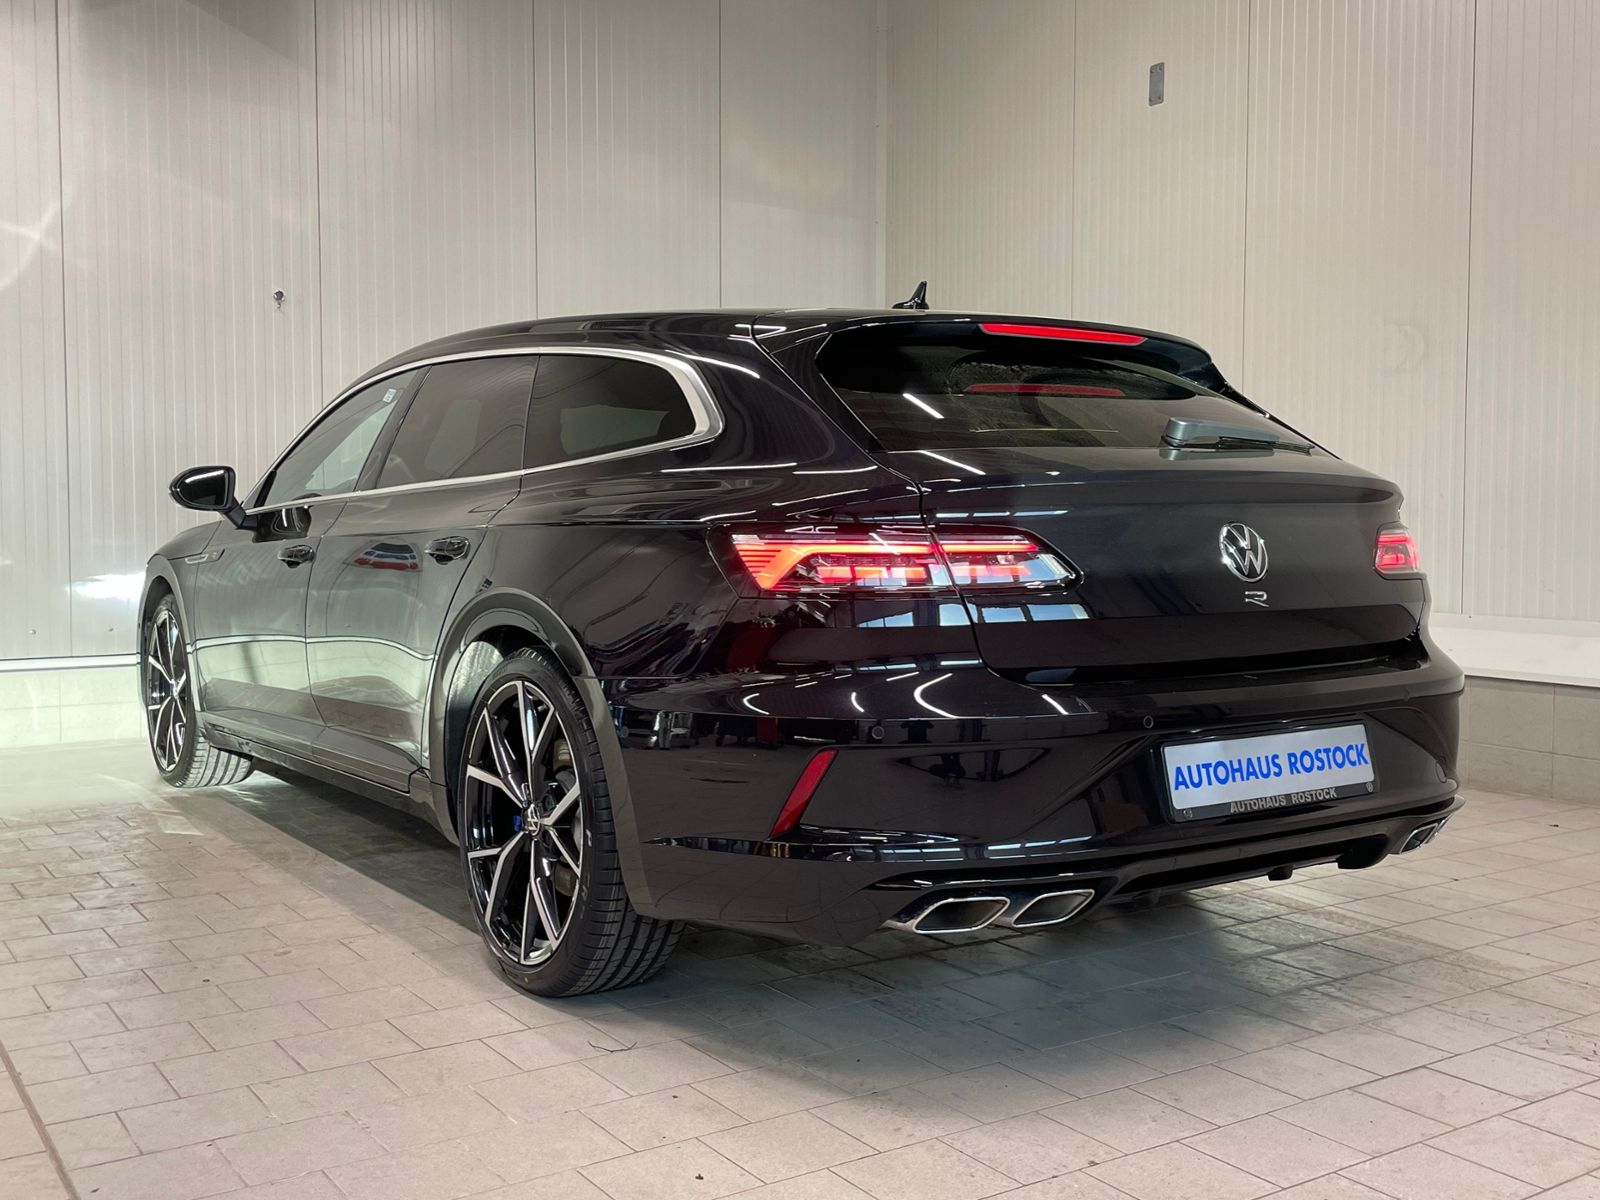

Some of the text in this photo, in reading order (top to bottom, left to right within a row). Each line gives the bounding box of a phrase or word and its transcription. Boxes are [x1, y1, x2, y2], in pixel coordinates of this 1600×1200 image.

[1244, 590, 1270, 608] R
[1174, 743, 1369, 791] AUTOHAUS ROSTOCK
[1230, 787, 1338, 814] AUTOHAUS ROSTOCK
